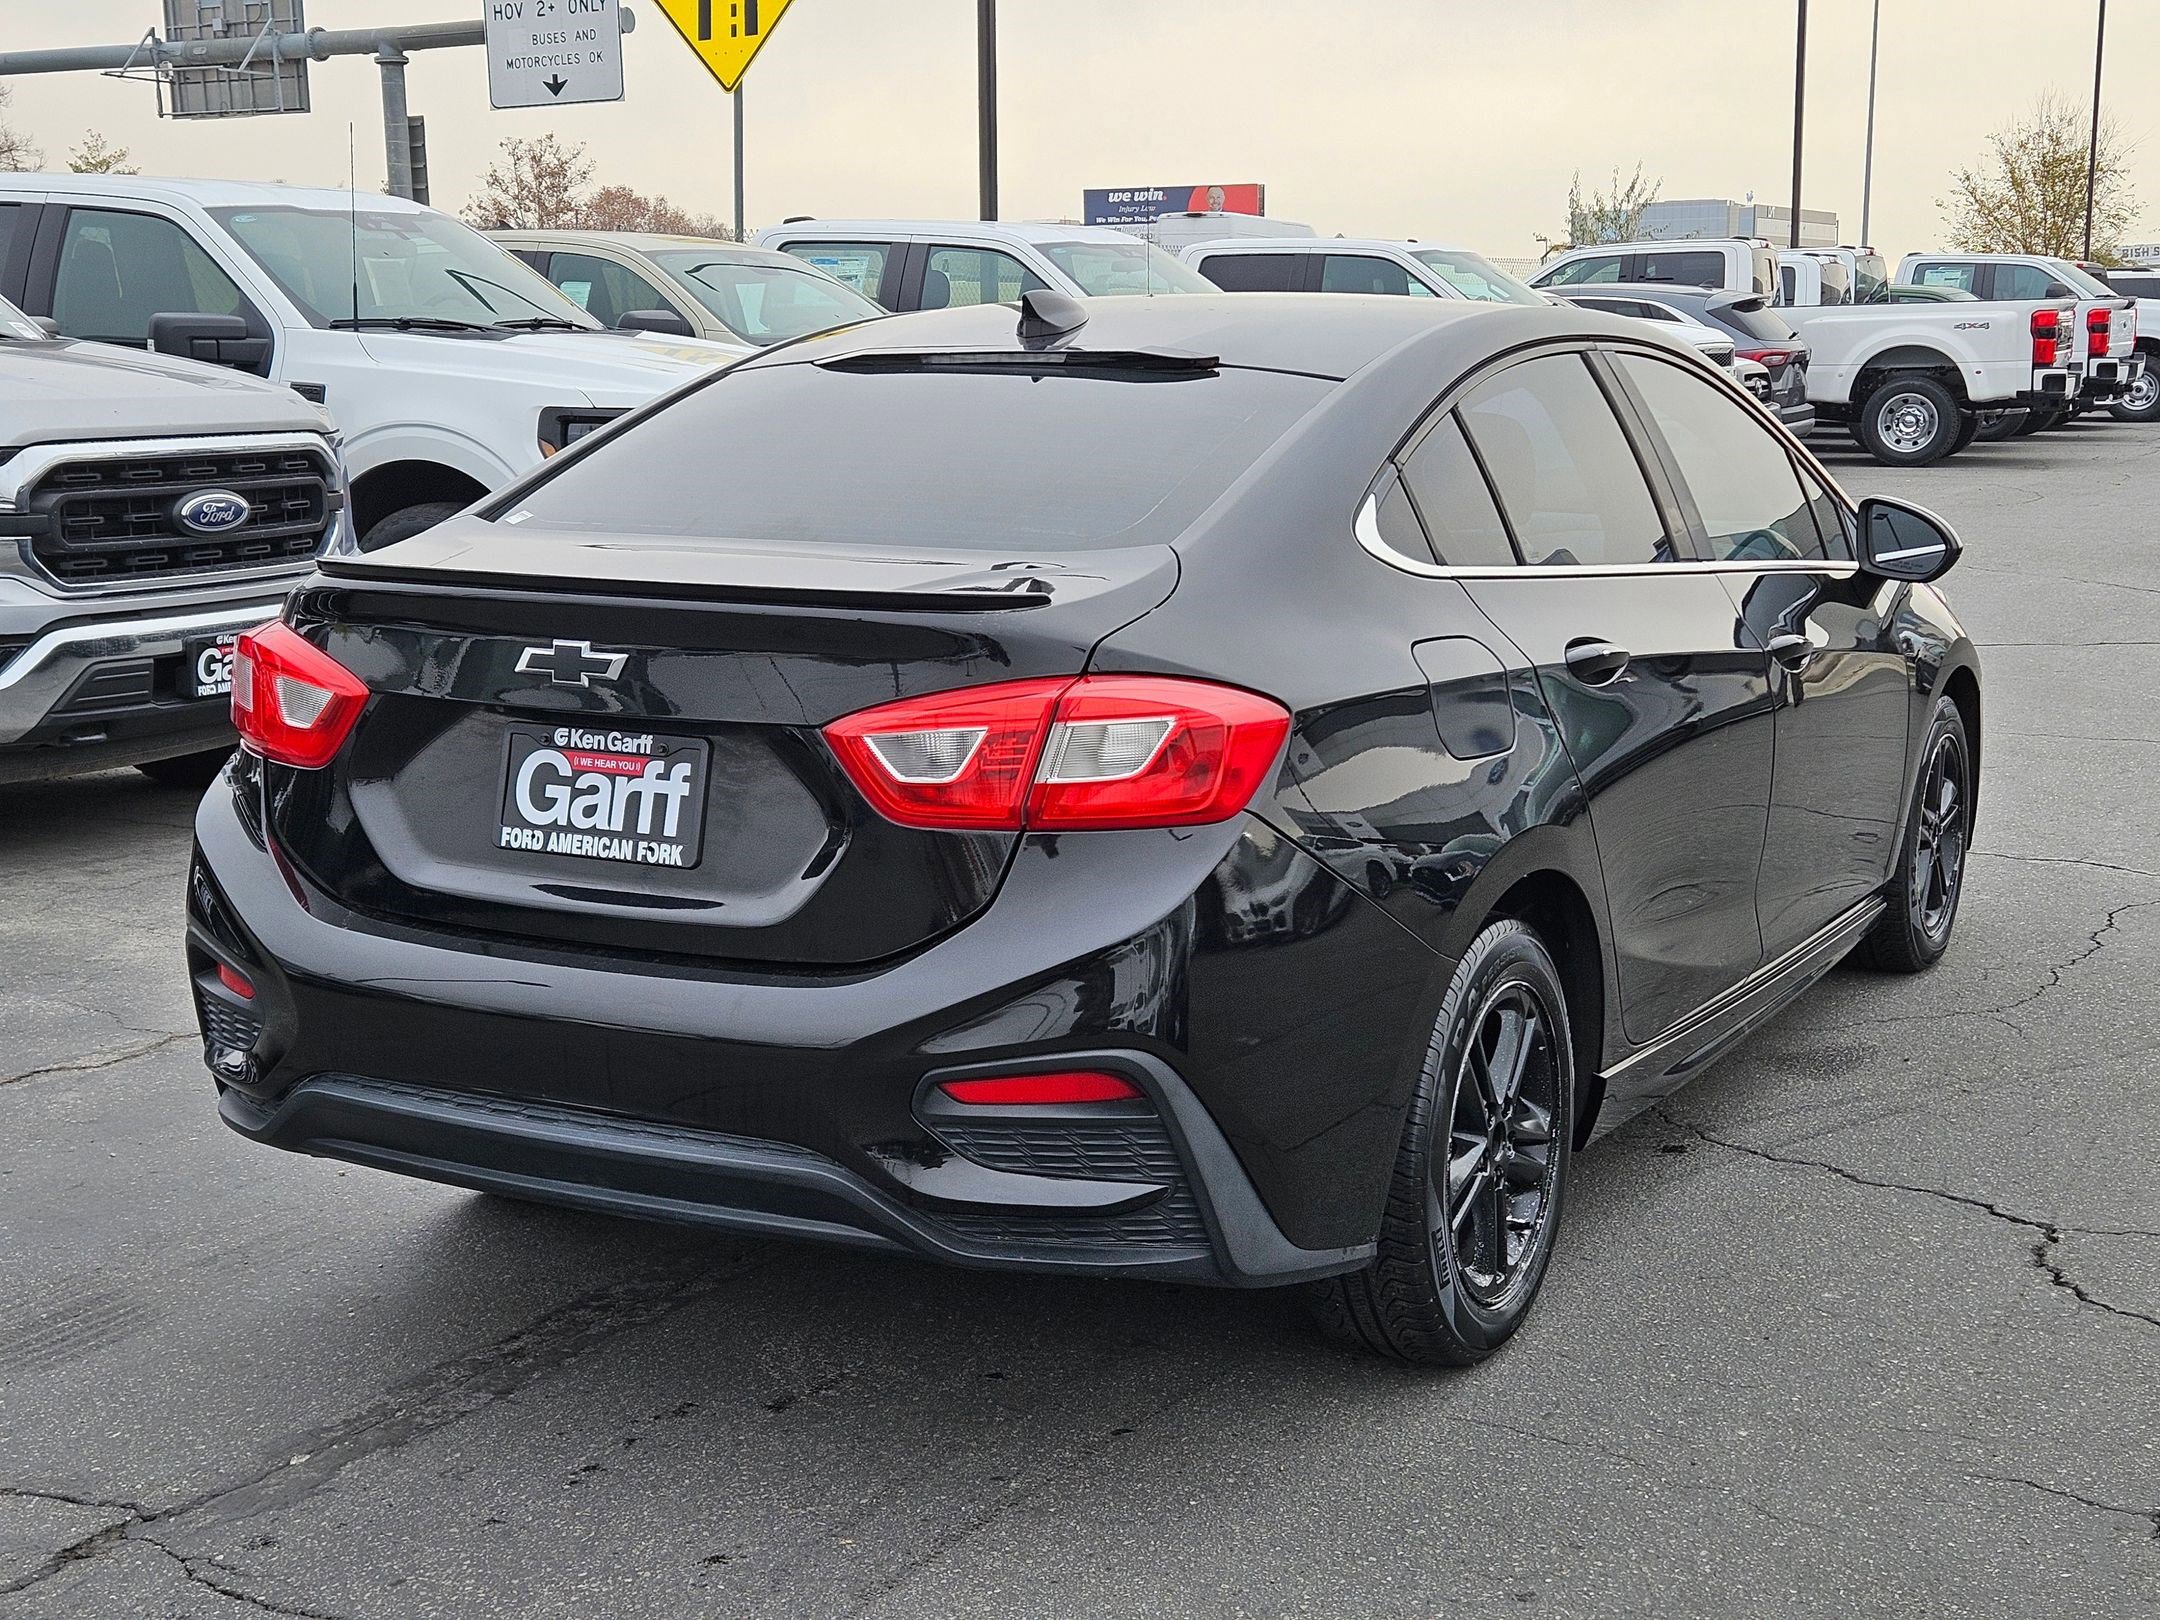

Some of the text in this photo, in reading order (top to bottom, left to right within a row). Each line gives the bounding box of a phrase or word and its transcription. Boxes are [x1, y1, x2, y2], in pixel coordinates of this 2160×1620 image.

[493, 0, 605, 21] HOV 2+ ONLY
[532, 28, 597, 46] BUSES AND
[506, 51, 604, 70] MOTORCYCLES OK
[1108, 191, 1131, 203] we
[1118, 205, 1140, 213] Injury
[200, 502, 235, 523] Ford
[570, 728, 654, 755] Ken Garff
[580, 758, 635, 771] WE HEAR YOU
[515, 749, 692, 838] Garff
[500, 826, 684, 866] FORD AMERICAN FORK
